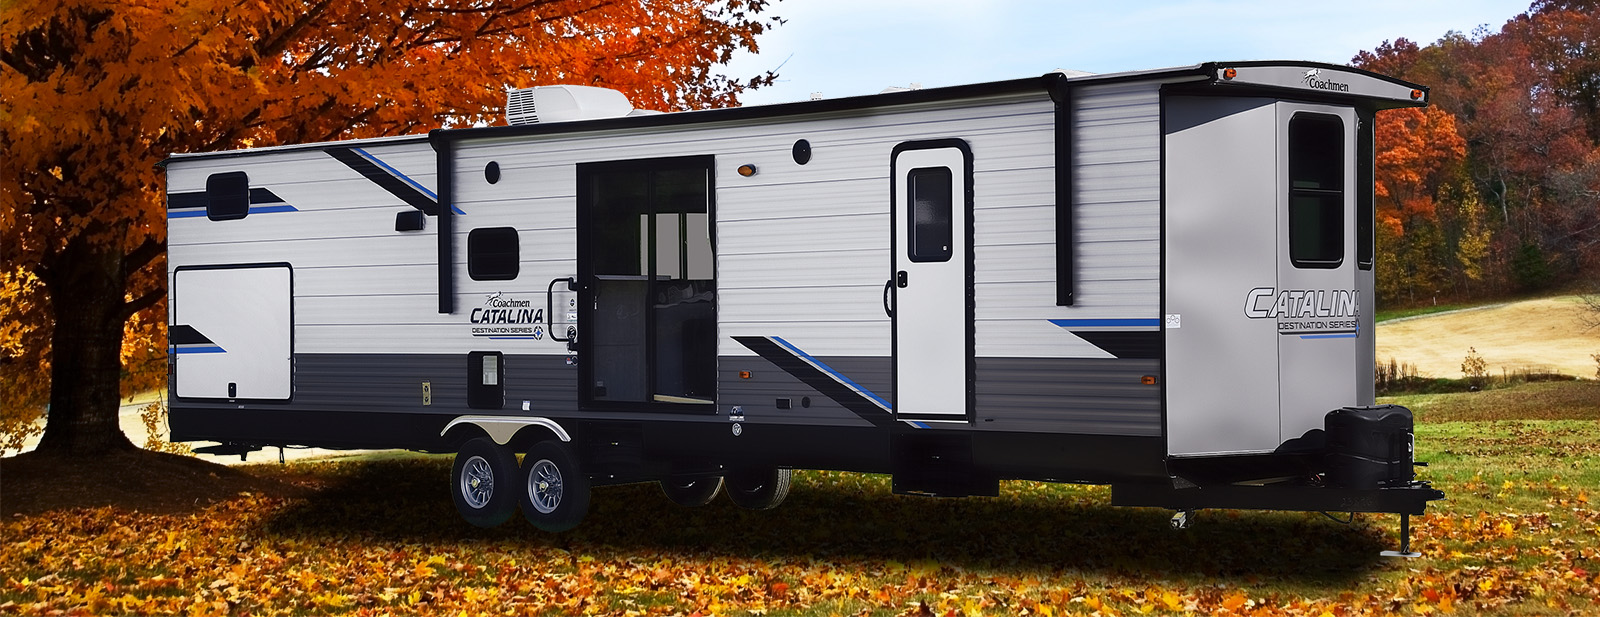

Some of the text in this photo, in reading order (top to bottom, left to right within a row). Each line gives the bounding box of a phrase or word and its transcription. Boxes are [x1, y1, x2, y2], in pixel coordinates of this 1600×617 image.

[1309, 78, 1349, 92] Coachmen
[492, 298, 530, 308] Coachmen
[470, 308, 544, 324] CATALINA
[1278, 320, 1357, 330] DESTINATION SERIES
